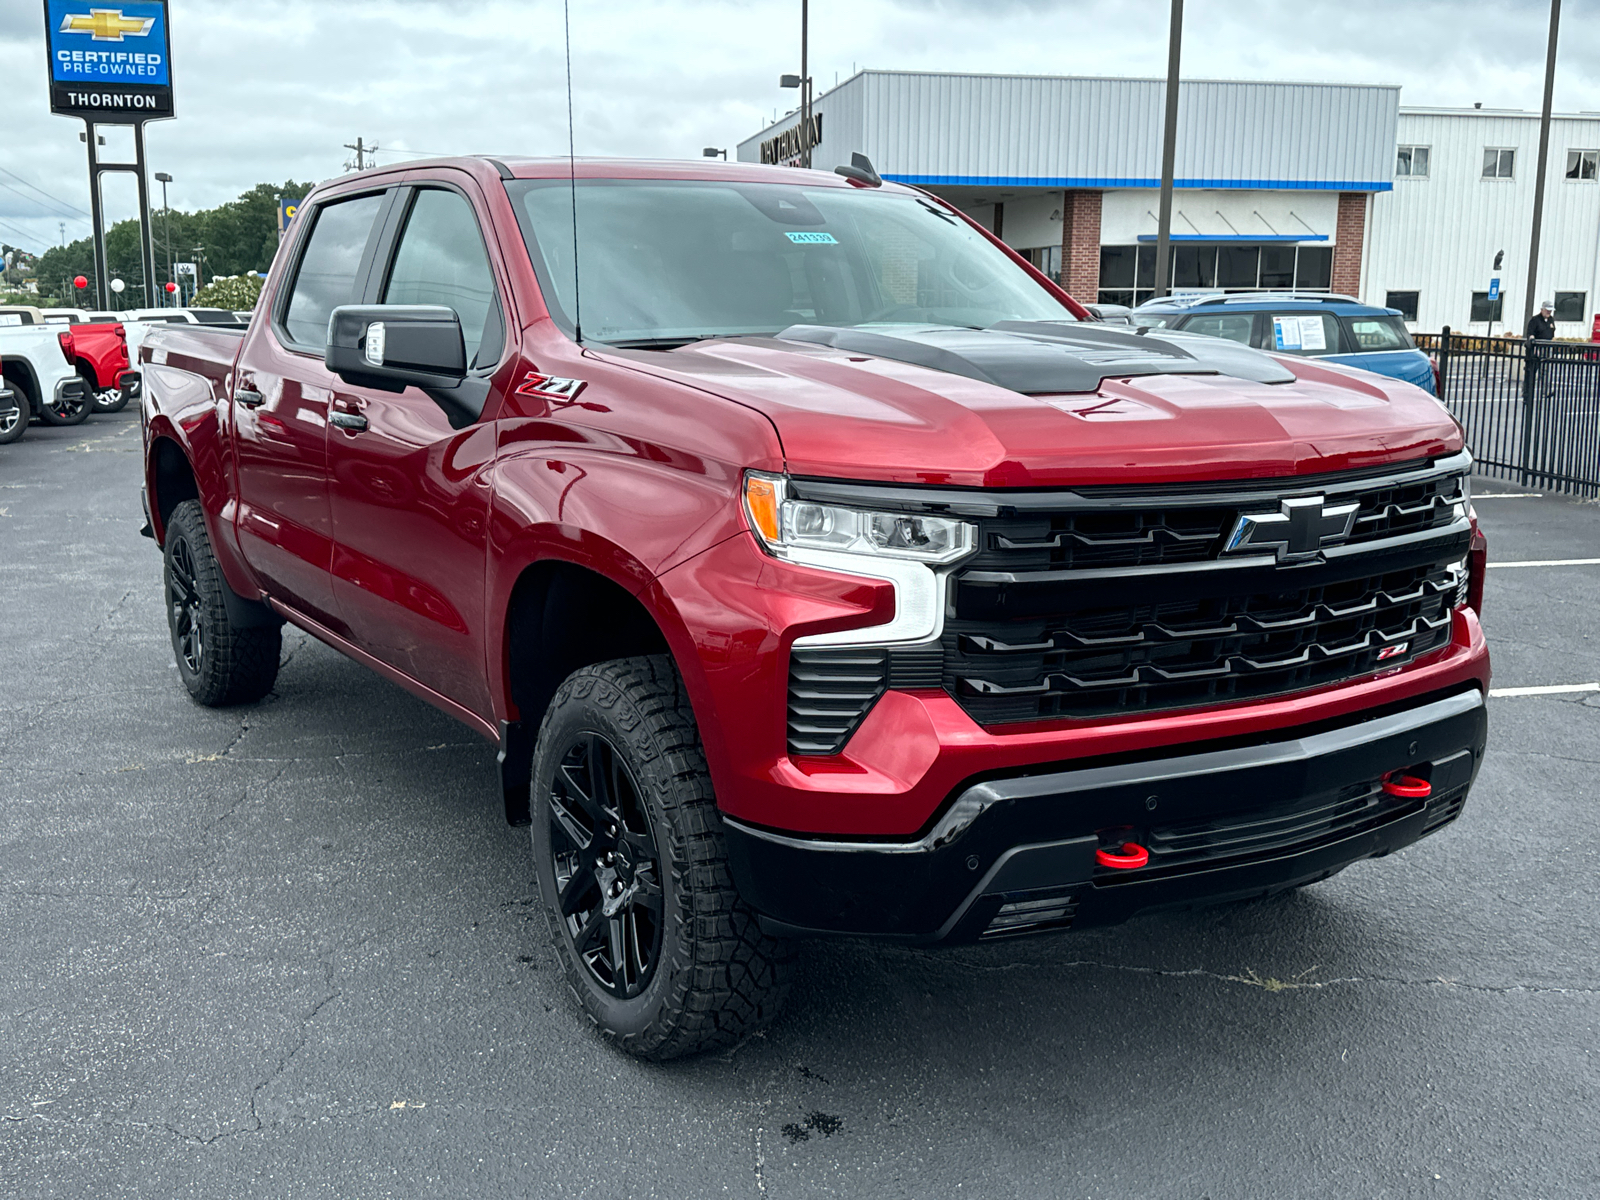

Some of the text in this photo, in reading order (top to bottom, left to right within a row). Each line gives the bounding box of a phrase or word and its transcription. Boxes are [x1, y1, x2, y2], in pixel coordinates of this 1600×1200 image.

[57, 50, 162, 65] CERTIFIED
[63, 62, 157, 76] PRE-OWNED
[68, 92, 156, 108] THORNTON
[778, 113, 823, 162] THORNON
[789, 233, 832, 242] 241339
[515, 371, 588, 403] Z71
